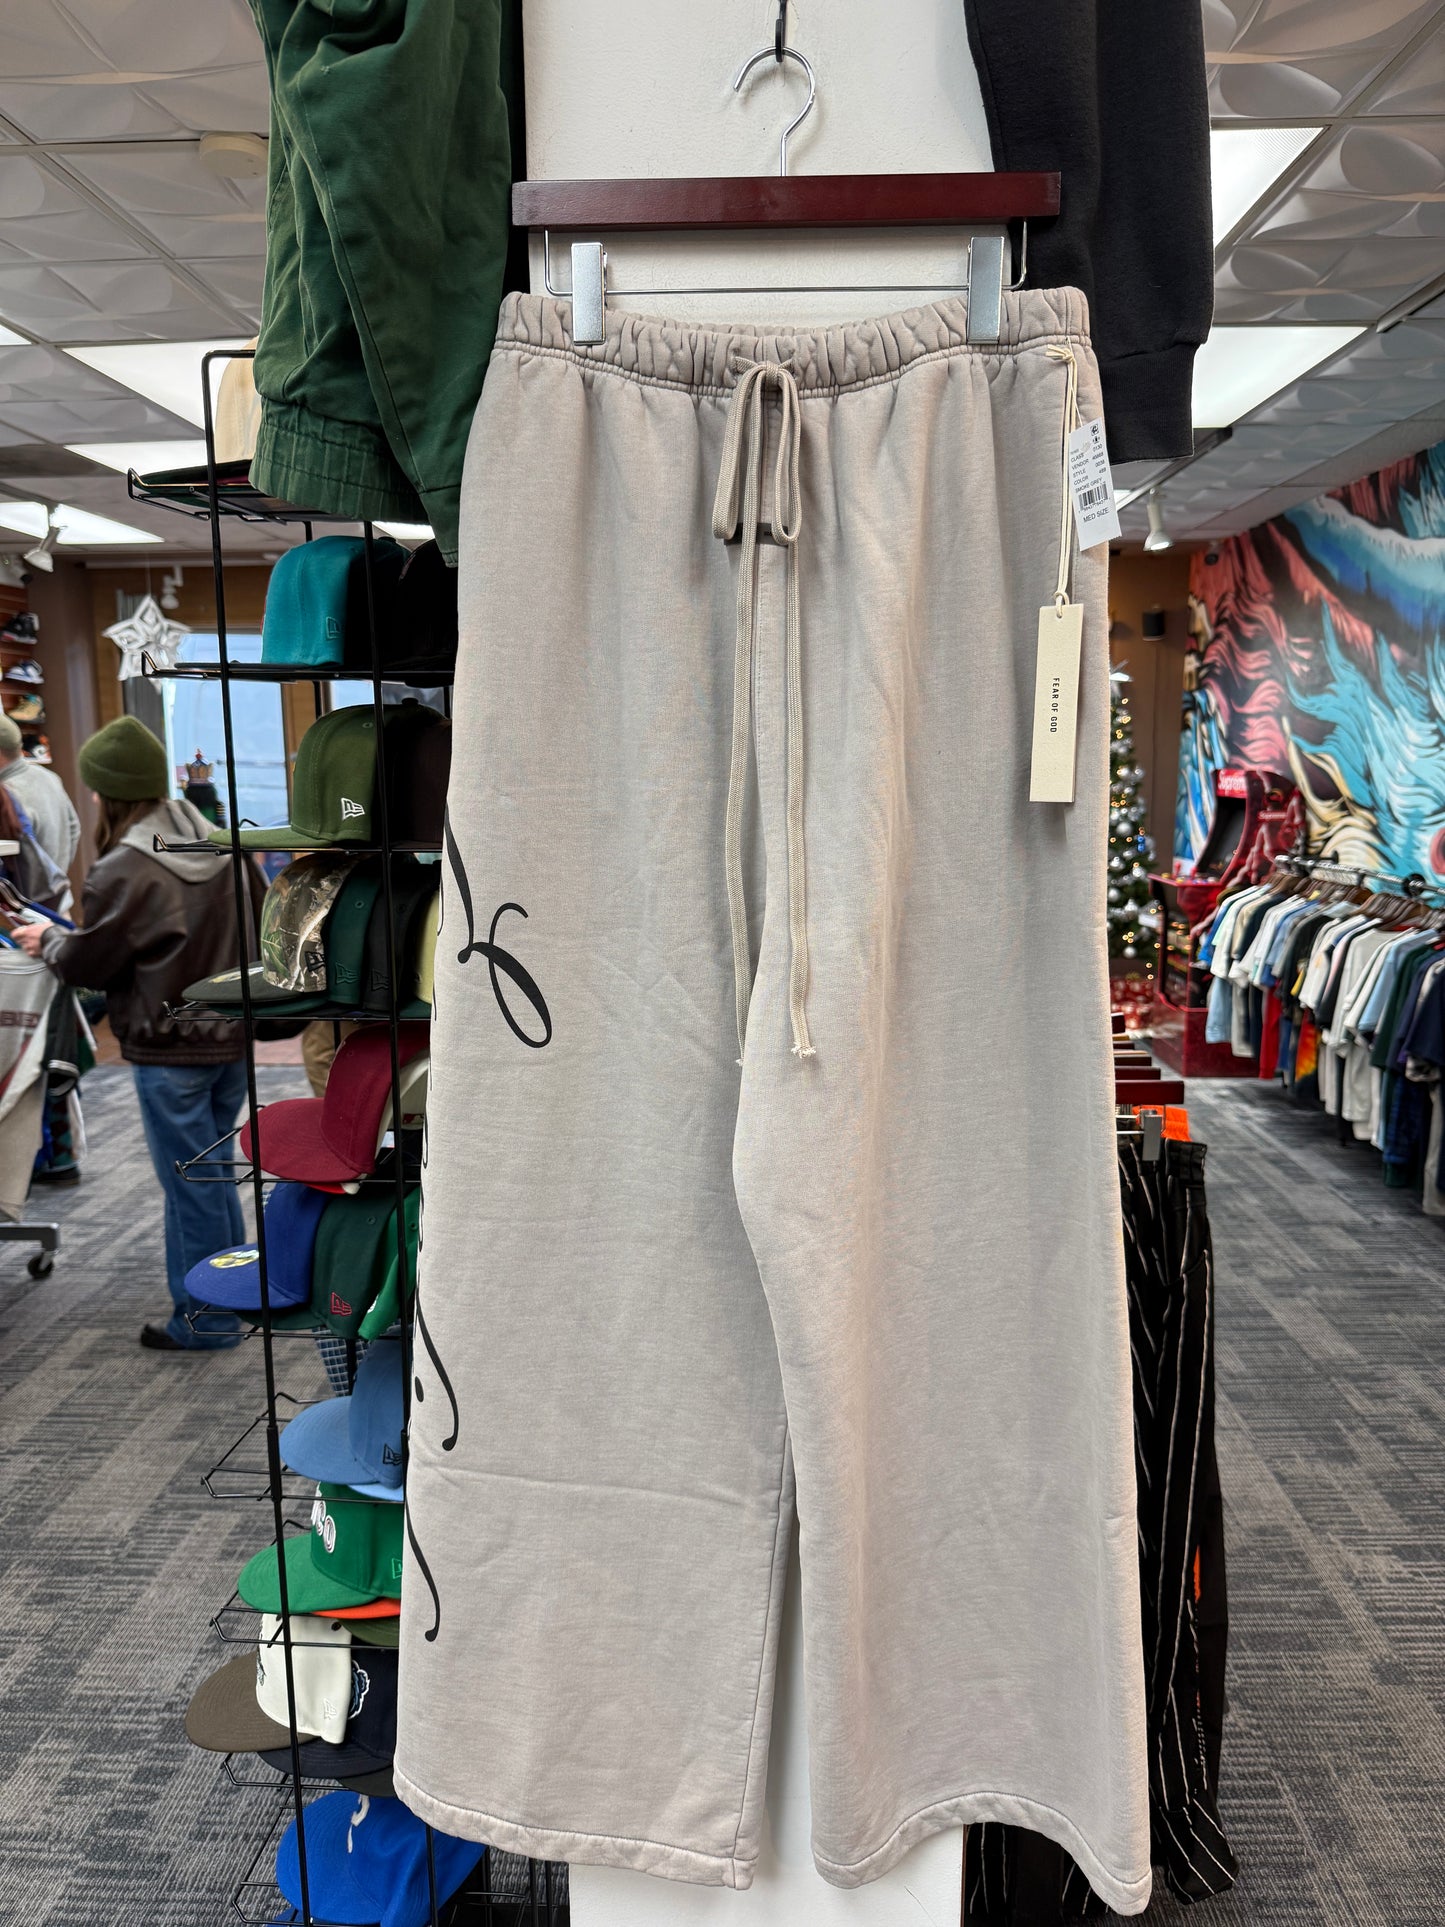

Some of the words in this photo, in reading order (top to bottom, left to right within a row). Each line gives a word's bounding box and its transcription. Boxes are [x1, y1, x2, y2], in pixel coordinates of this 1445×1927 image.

[1071, 452, 1084, 462] CLASS
[1072, 458, 1089, 470] VENDOR
[1073, 468, 1086, 478] STYLE
[1074, 475, 1089, 486] COLOR
[1075, 482, 1090, 493] SMOKE
[1090, 477, 1102, 486] GREY
[1083, 513, 1096, 522] MED
[1097, 507, 1109, 517] SIZE
[1052, 677, 1060, 699] FEAR
[1051, 702, 1059, 713] OF
[1049, 716, 1058, 733] GOD
[1218, 769, 1247, 796] Suprem
